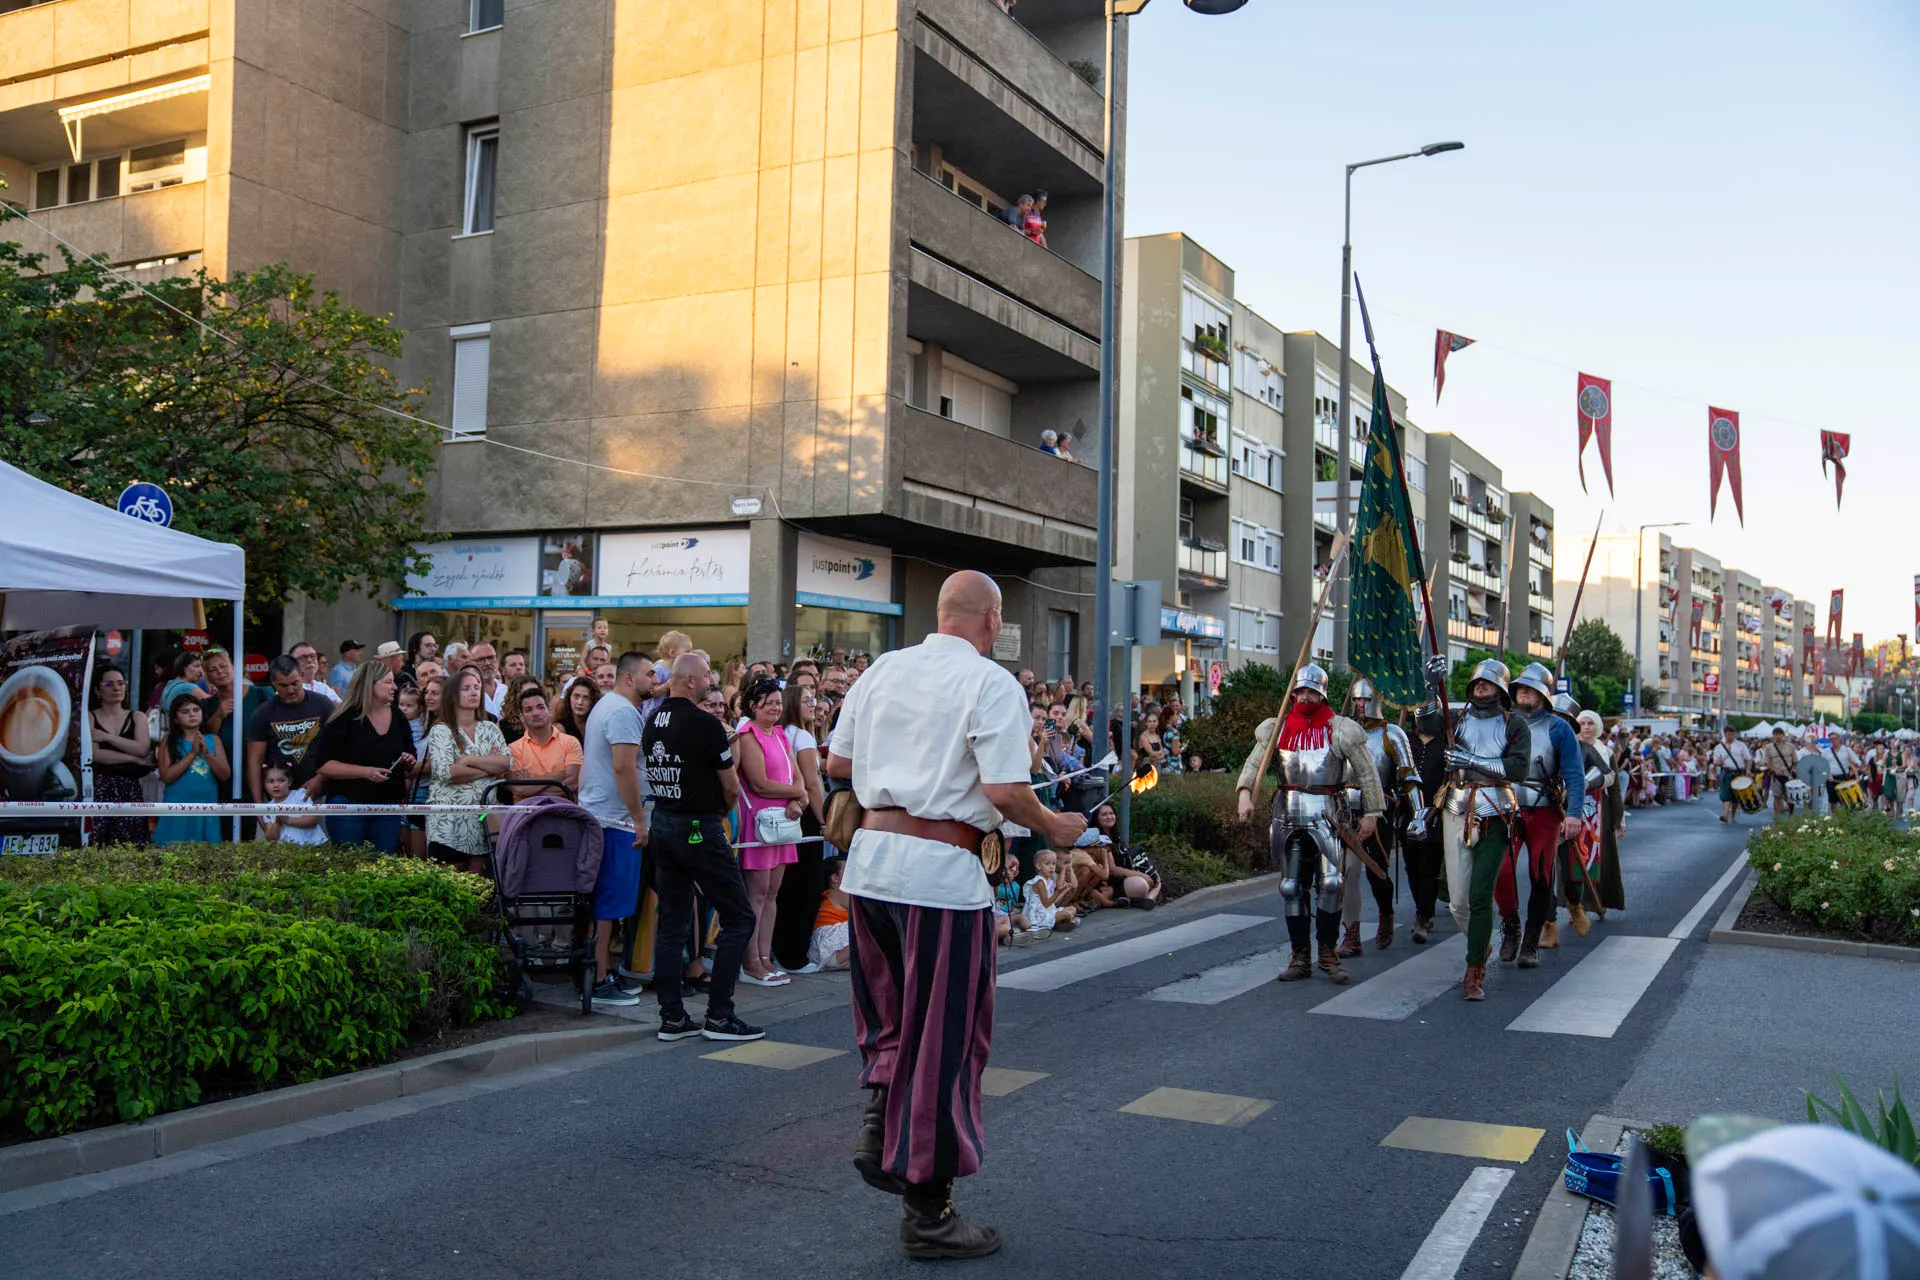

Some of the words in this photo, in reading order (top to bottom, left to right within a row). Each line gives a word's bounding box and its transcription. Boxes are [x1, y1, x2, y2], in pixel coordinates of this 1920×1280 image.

[627, 557, 685, 588] Kerámia
[686, 555, 725, 585] festés
[183, 635, 209, 646] 20%
[244, 661, 270, 673] AKCIÓ
[653, 711, 672, 728] 404
[275, 720, 317, 734] Wrangler
[59, 803, 111, 811] SAVARIA
[168, 804, 214, 812] SAVARIA
